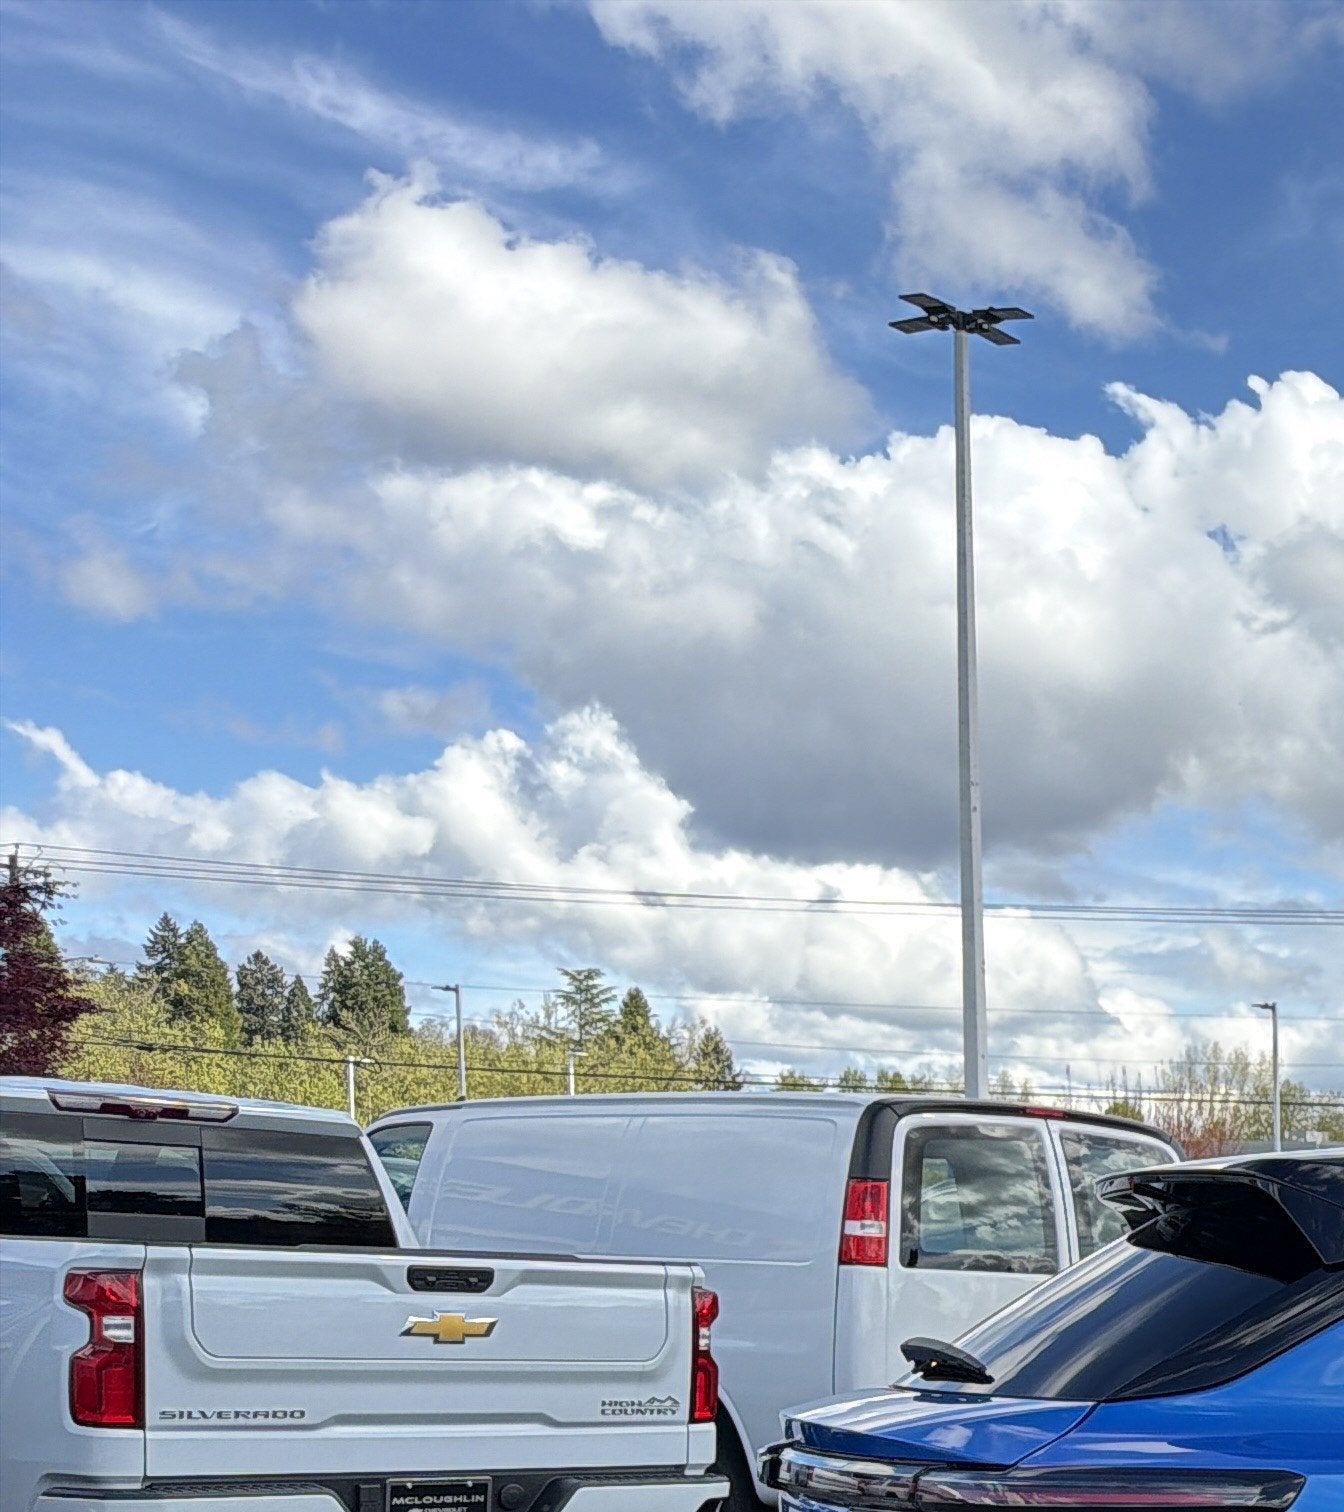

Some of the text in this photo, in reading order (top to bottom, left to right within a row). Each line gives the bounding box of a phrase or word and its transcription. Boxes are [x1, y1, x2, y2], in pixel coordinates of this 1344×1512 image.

[600, 1399, 643, 1408] HIGH
[158, 1409, 306, 1420] SILVERADO
[600, 1407, 679, 1416] COUNTRY
[391, 1494, 486, 1506] MCLOUGHLIN
